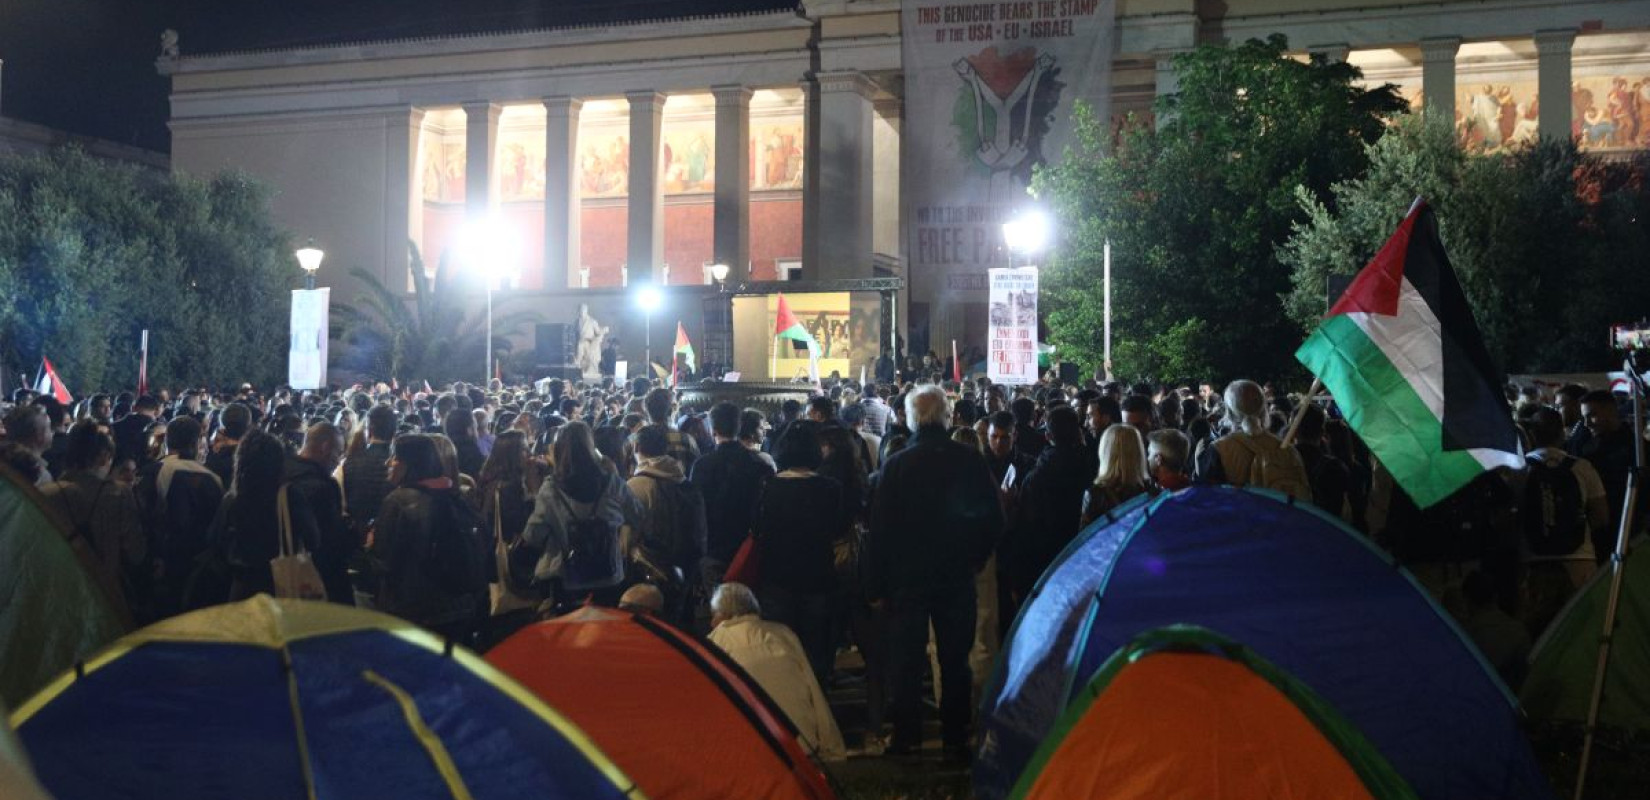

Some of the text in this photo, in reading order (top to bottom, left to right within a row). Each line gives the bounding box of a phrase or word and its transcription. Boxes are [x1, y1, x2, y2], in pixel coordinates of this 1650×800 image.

[917, 0, 1098, 25] THIS GENOCIDE BEARS THE STAMP
[935, 18, 1075, 42] OF THE USA EU ISRAEL
[918, 228, 964, 265] FREE
